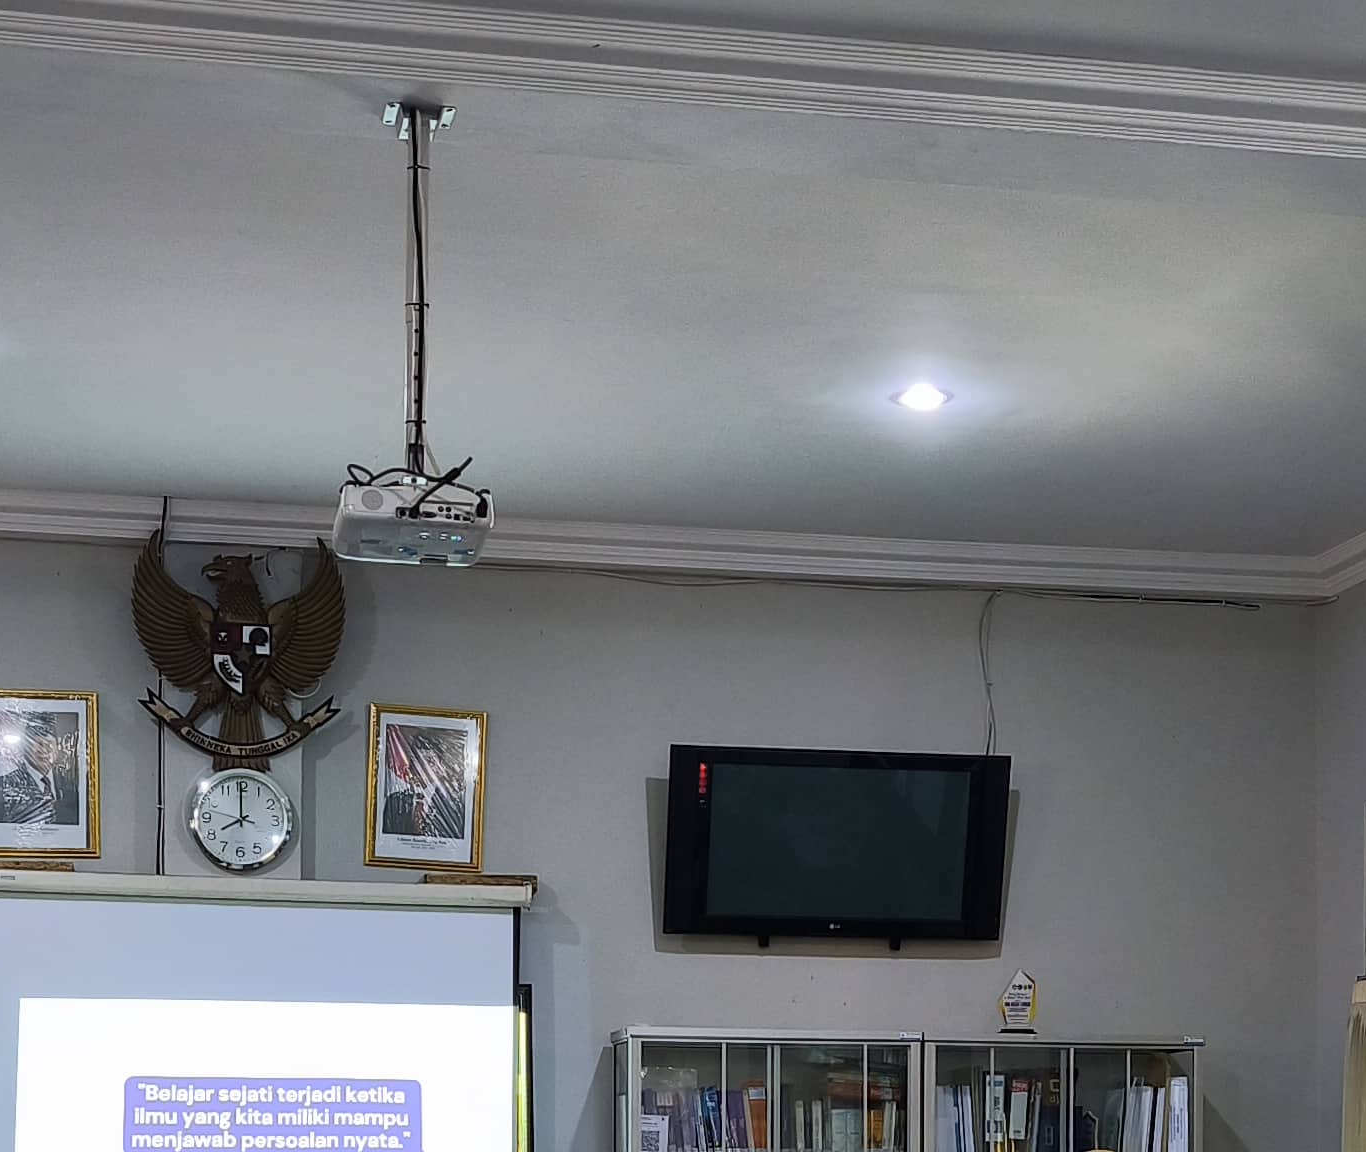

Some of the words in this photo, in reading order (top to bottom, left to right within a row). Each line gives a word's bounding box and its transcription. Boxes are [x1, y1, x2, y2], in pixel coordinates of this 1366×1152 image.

[185, 728, 232, 755] BHINNEKA
[238, 741, 282, 756] TUNGGAL
[283, 732, 299, 746] IKA
[221, 784, 230, 797] 11
[266, 798, 275, 810] 2
[202, 811, 211, 823] 9
[271, 815, 280, 827] 3
[207, 828, 216, 840] 8
[220, 841, 228, 853] 7
[236, 846, 245, 858] 6
[253, 843, 262, 854] 5
[137, 1083, 215, 1107] "Belajar
[218, 1084, 273, 1107] sejati
[276, 1085, 342, 1107] terjadi
[345, 1085, 406, 1104] ketika
[133, 1107, 178, 1126] ilmu
[182, 1111, 232, 1131] yang
[235, 1107, 274, 1126] kita
[278, 1107, 330, 1126] miliki
[334, 1112, 410, 1130] mampu
[131, 1131, 237, 1152] menjawab
[241, 1131, 340, 1152] persoalan
[343, 1130, 412, 1152] nyata."
